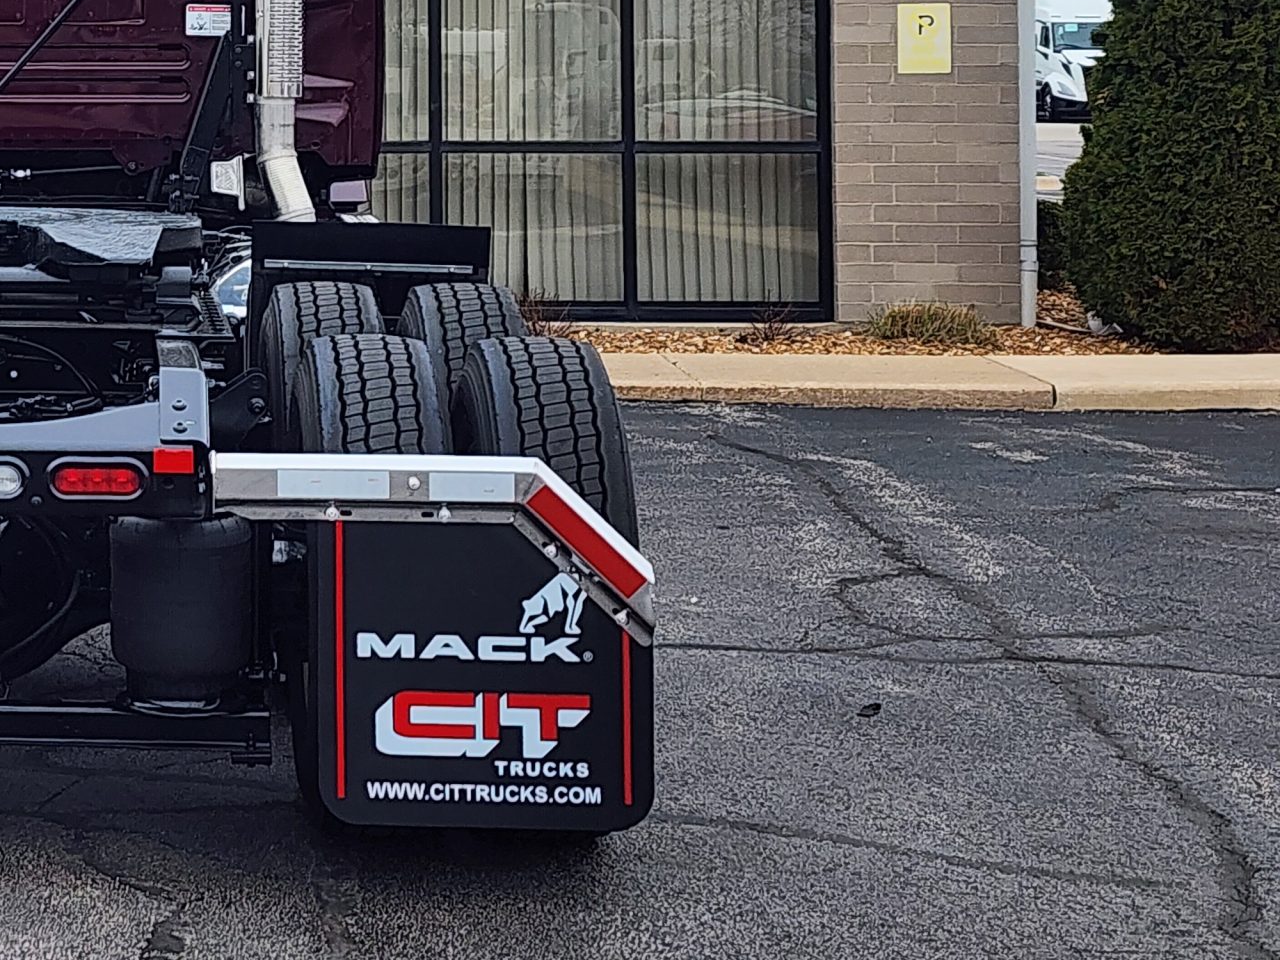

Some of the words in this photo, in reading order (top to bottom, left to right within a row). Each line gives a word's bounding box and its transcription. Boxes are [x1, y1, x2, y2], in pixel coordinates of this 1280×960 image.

[356, 632, 582, 663] MACK
[391, 689, 591, 742] CIT
[494, 760, 590, 778] TRUCKS
[366, 780, 602, 805] WWW.CITTRUCKS.COM
